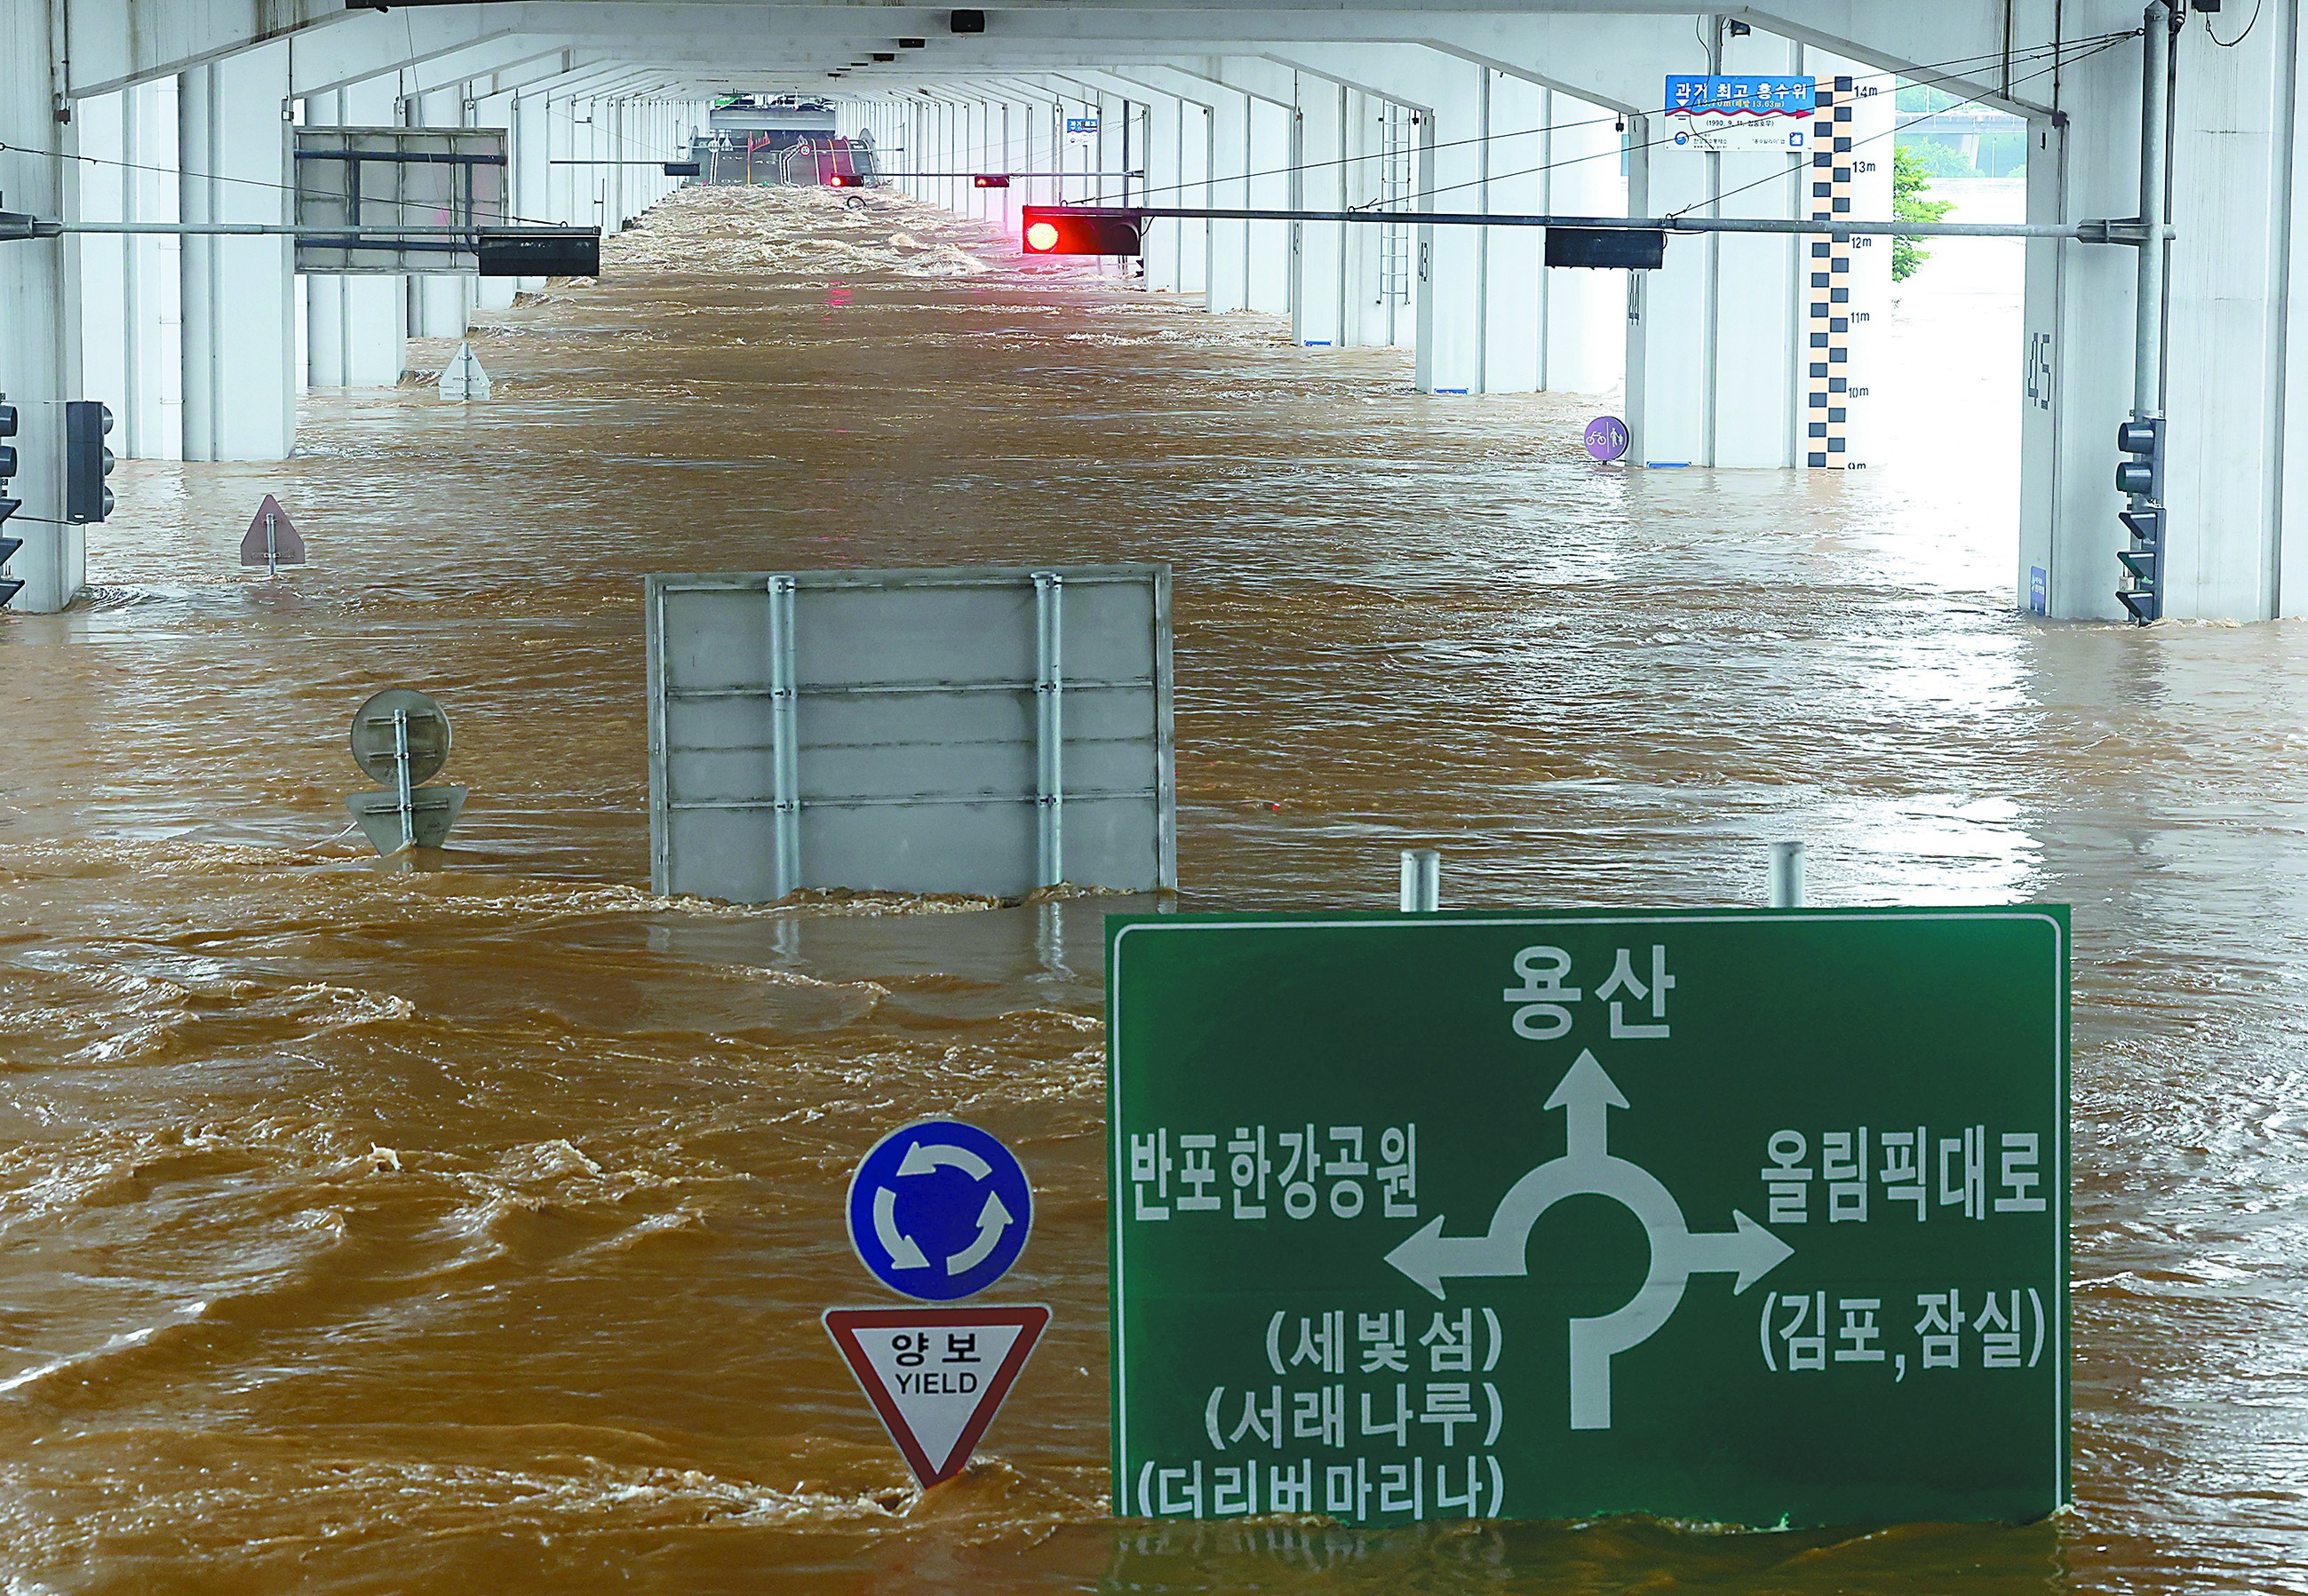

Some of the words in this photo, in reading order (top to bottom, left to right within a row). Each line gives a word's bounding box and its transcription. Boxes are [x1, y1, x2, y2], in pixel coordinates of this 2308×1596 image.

[1675, 83, 1708, 99] 과거
[1716, 83, 1748, 99] 최고
[1854, 84, 1878, 99] 14m
[1852, 161, 1876, 173] 13m
[1850, 236, 1872, 249] 12m
[1850, 311, 1870, 323] 11m
[1848, 386, 1869, 399] 10m
[2027, 332, 2051, 410] 45
[1503, 944, 1676, 1040] 용산
[1130, 1123, 1419, 1221] 반포한강공원
[1761, 1124, 2047, 1223] 올림픽대로
[1266, 1307, 1503, 1375] (세빛섬)
[895, 1372, 978, 1394] YIELD
[1205, 1382, 1503, 1450] (서래나루)
[1137, 1455, 1505, 1521] (더리버마리나)
